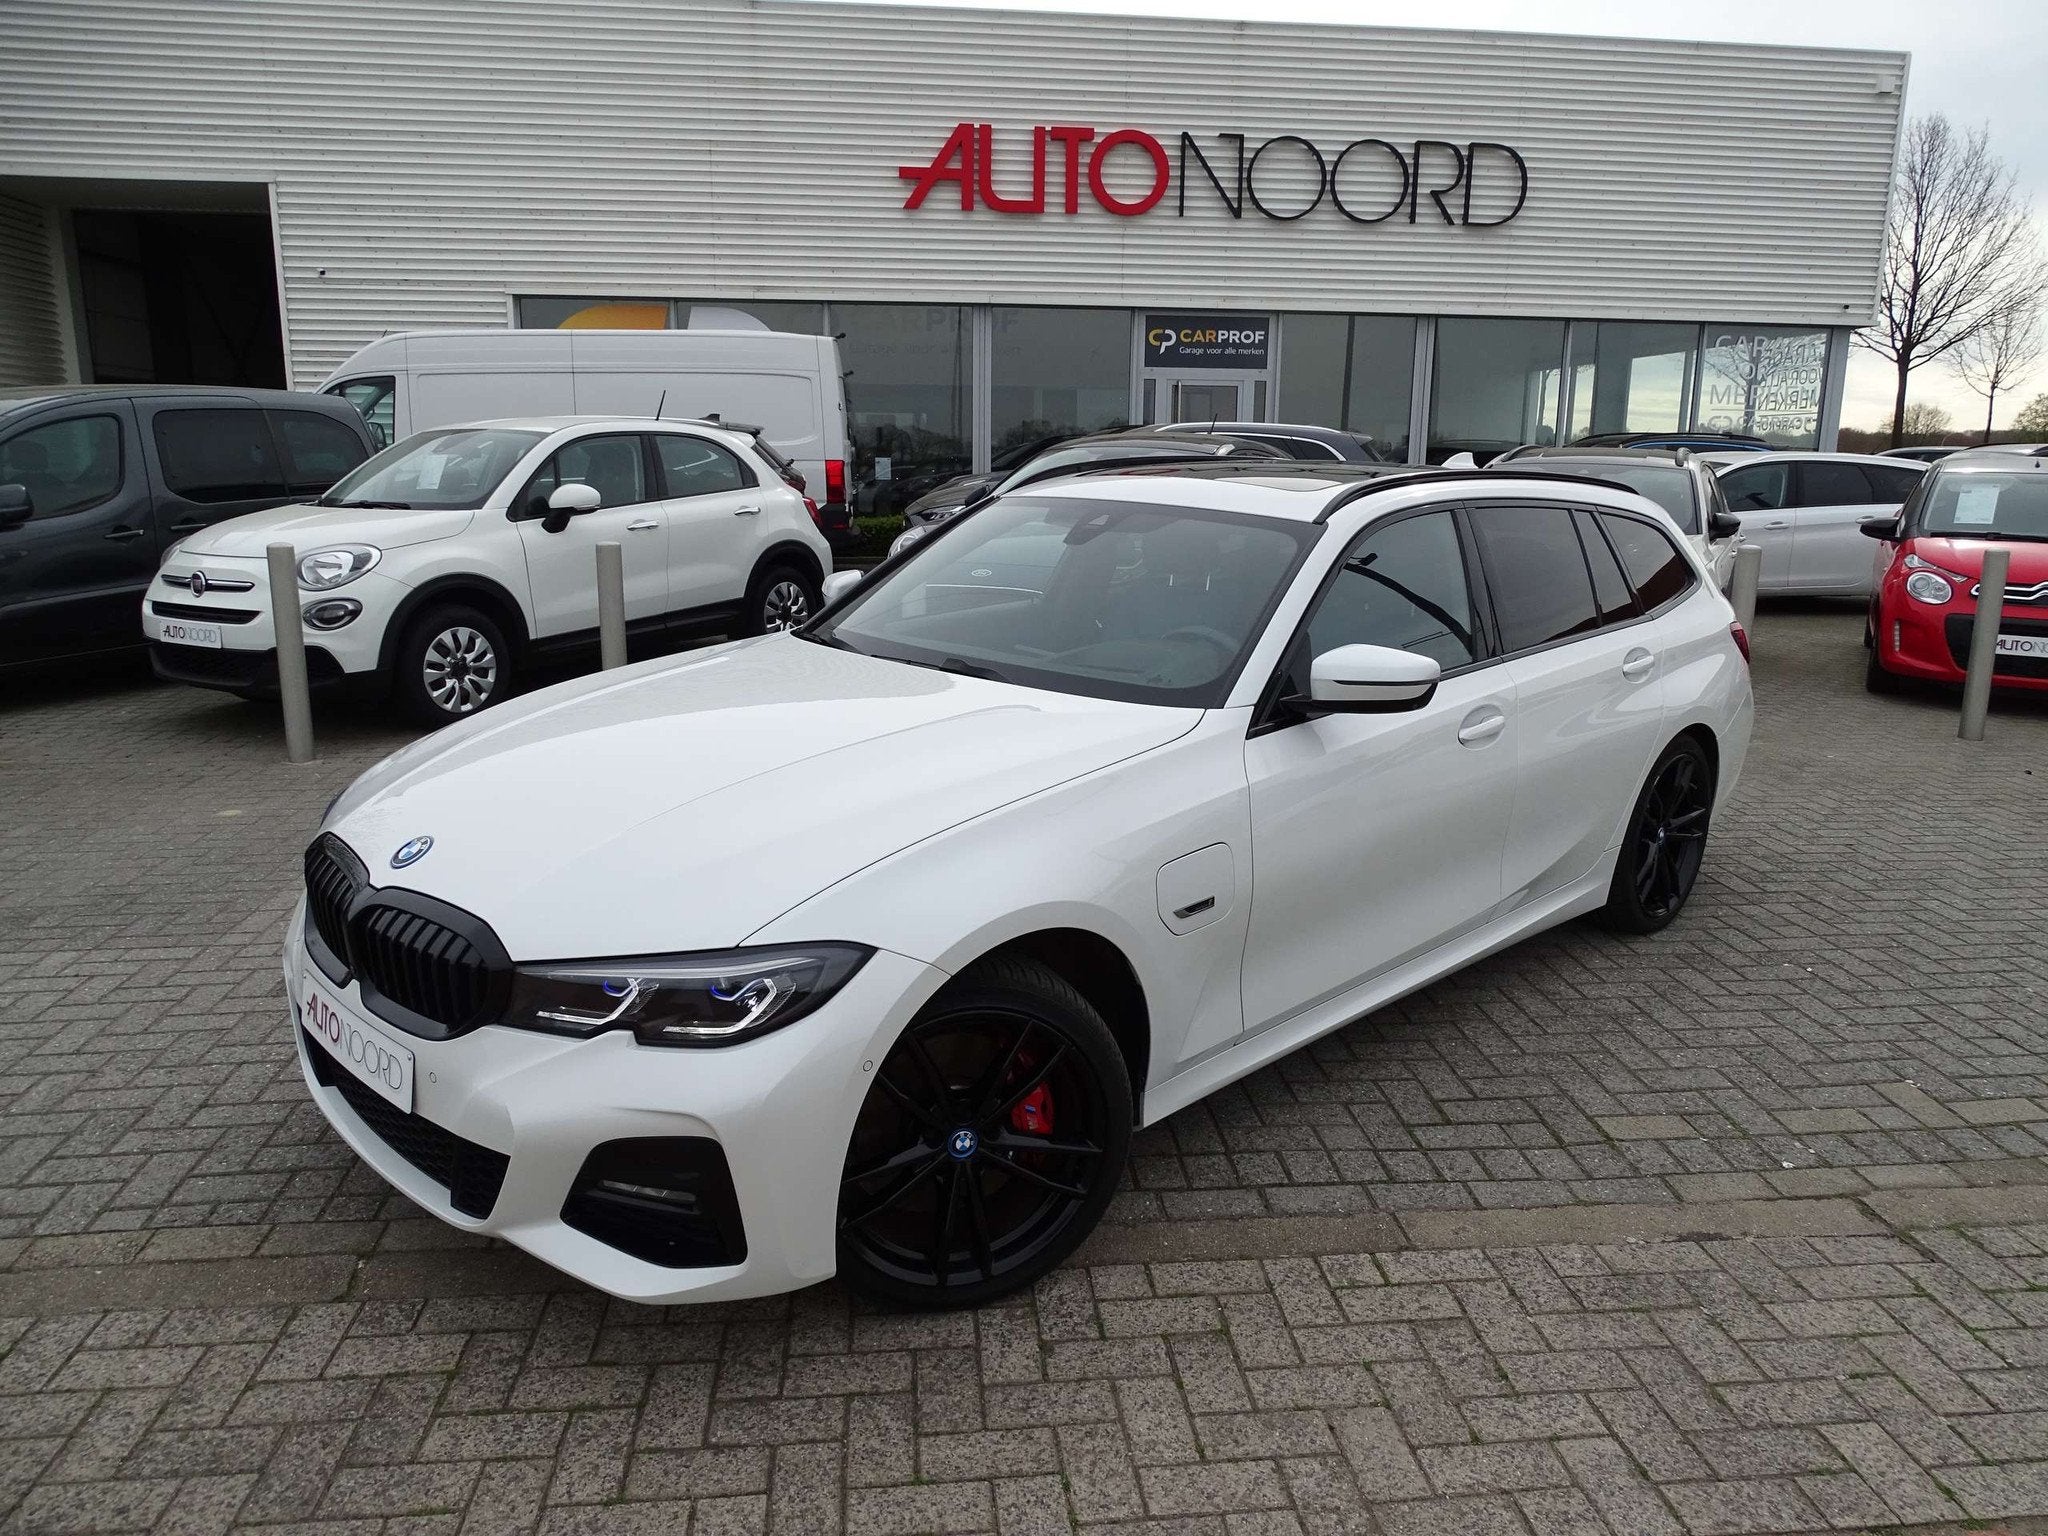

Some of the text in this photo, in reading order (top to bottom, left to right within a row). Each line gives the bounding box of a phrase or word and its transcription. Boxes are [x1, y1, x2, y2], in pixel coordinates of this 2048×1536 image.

[1180, 330, 1265, 343] CARPROF
[1179, 346, 1204, 355] Garage
[1238, 347, 1264, 355] merken
